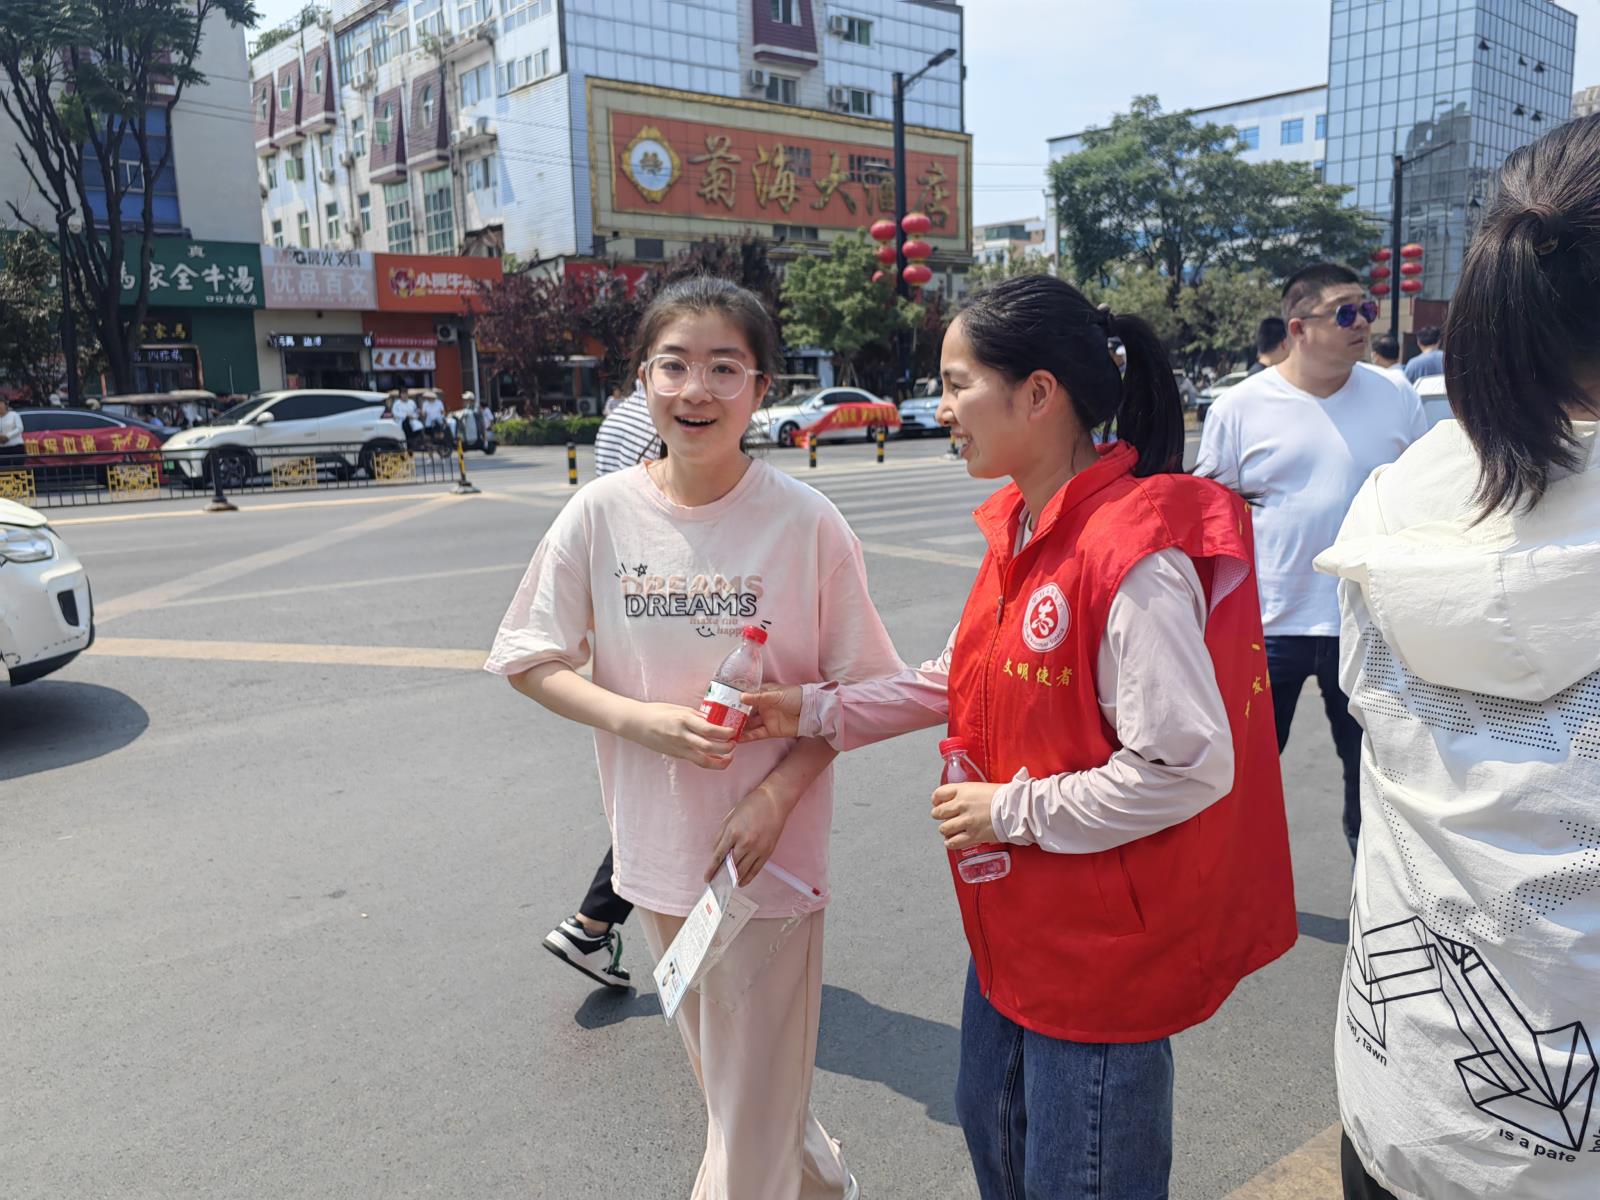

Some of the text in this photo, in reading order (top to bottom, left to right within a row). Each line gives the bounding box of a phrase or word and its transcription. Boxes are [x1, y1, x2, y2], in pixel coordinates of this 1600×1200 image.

[271, 267, 369, 295] 优品百文
[620, 574, 765, 599] DREAMS
[624, 593, 758, 617] DREAMS
[1003, 657, 1073, 687] 文明使者
[1518, 1137, 1530, 1149] a
[1533, 1143, 1577, 1163] pate
